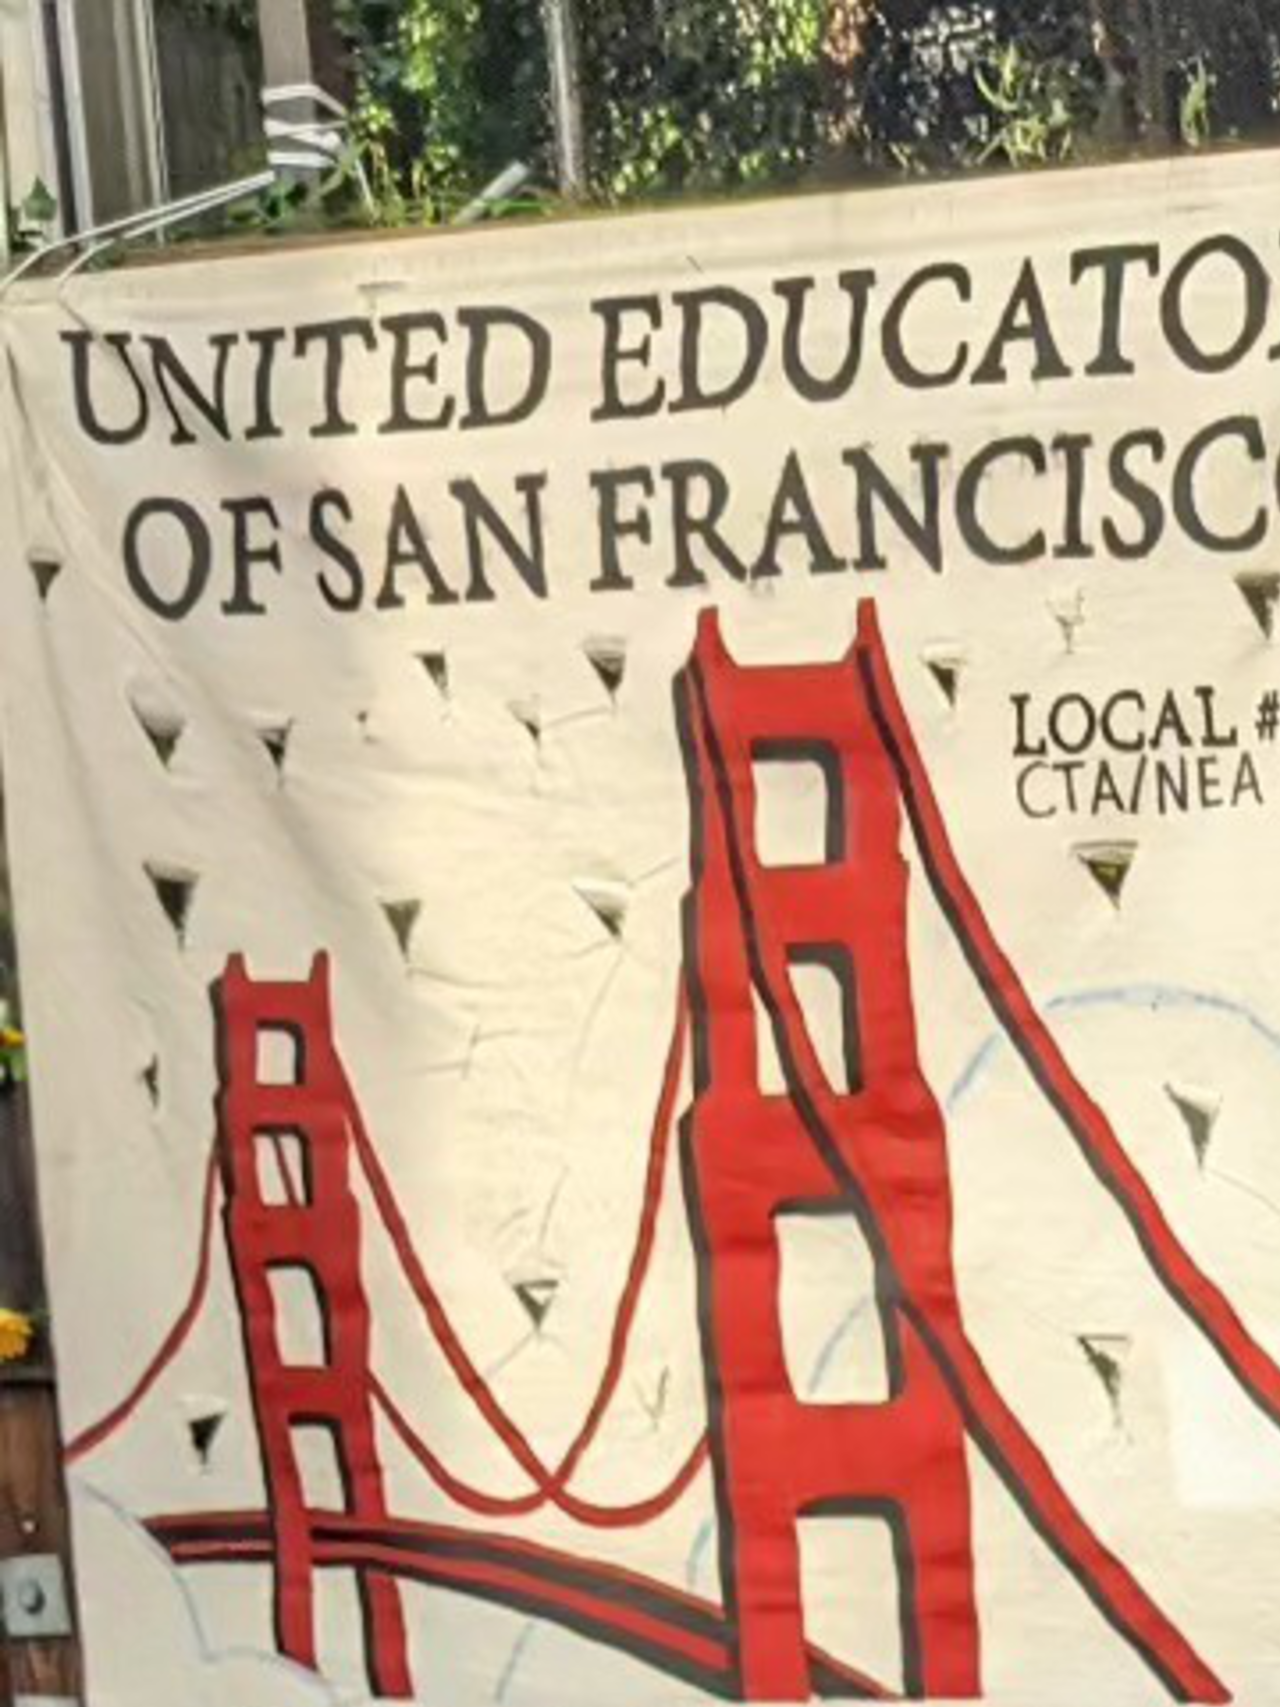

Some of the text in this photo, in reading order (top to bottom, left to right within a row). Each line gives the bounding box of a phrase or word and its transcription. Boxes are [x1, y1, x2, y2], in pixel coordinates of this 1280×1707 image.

[58, 305, 551, 445] UNITED
[122, 496, 283, 620] OF
[308, 473, 549, 613] SAN
[1009, 685, 1238, 757] LOCAL
[1016, 750, 1264, 818] CTA/NEA
